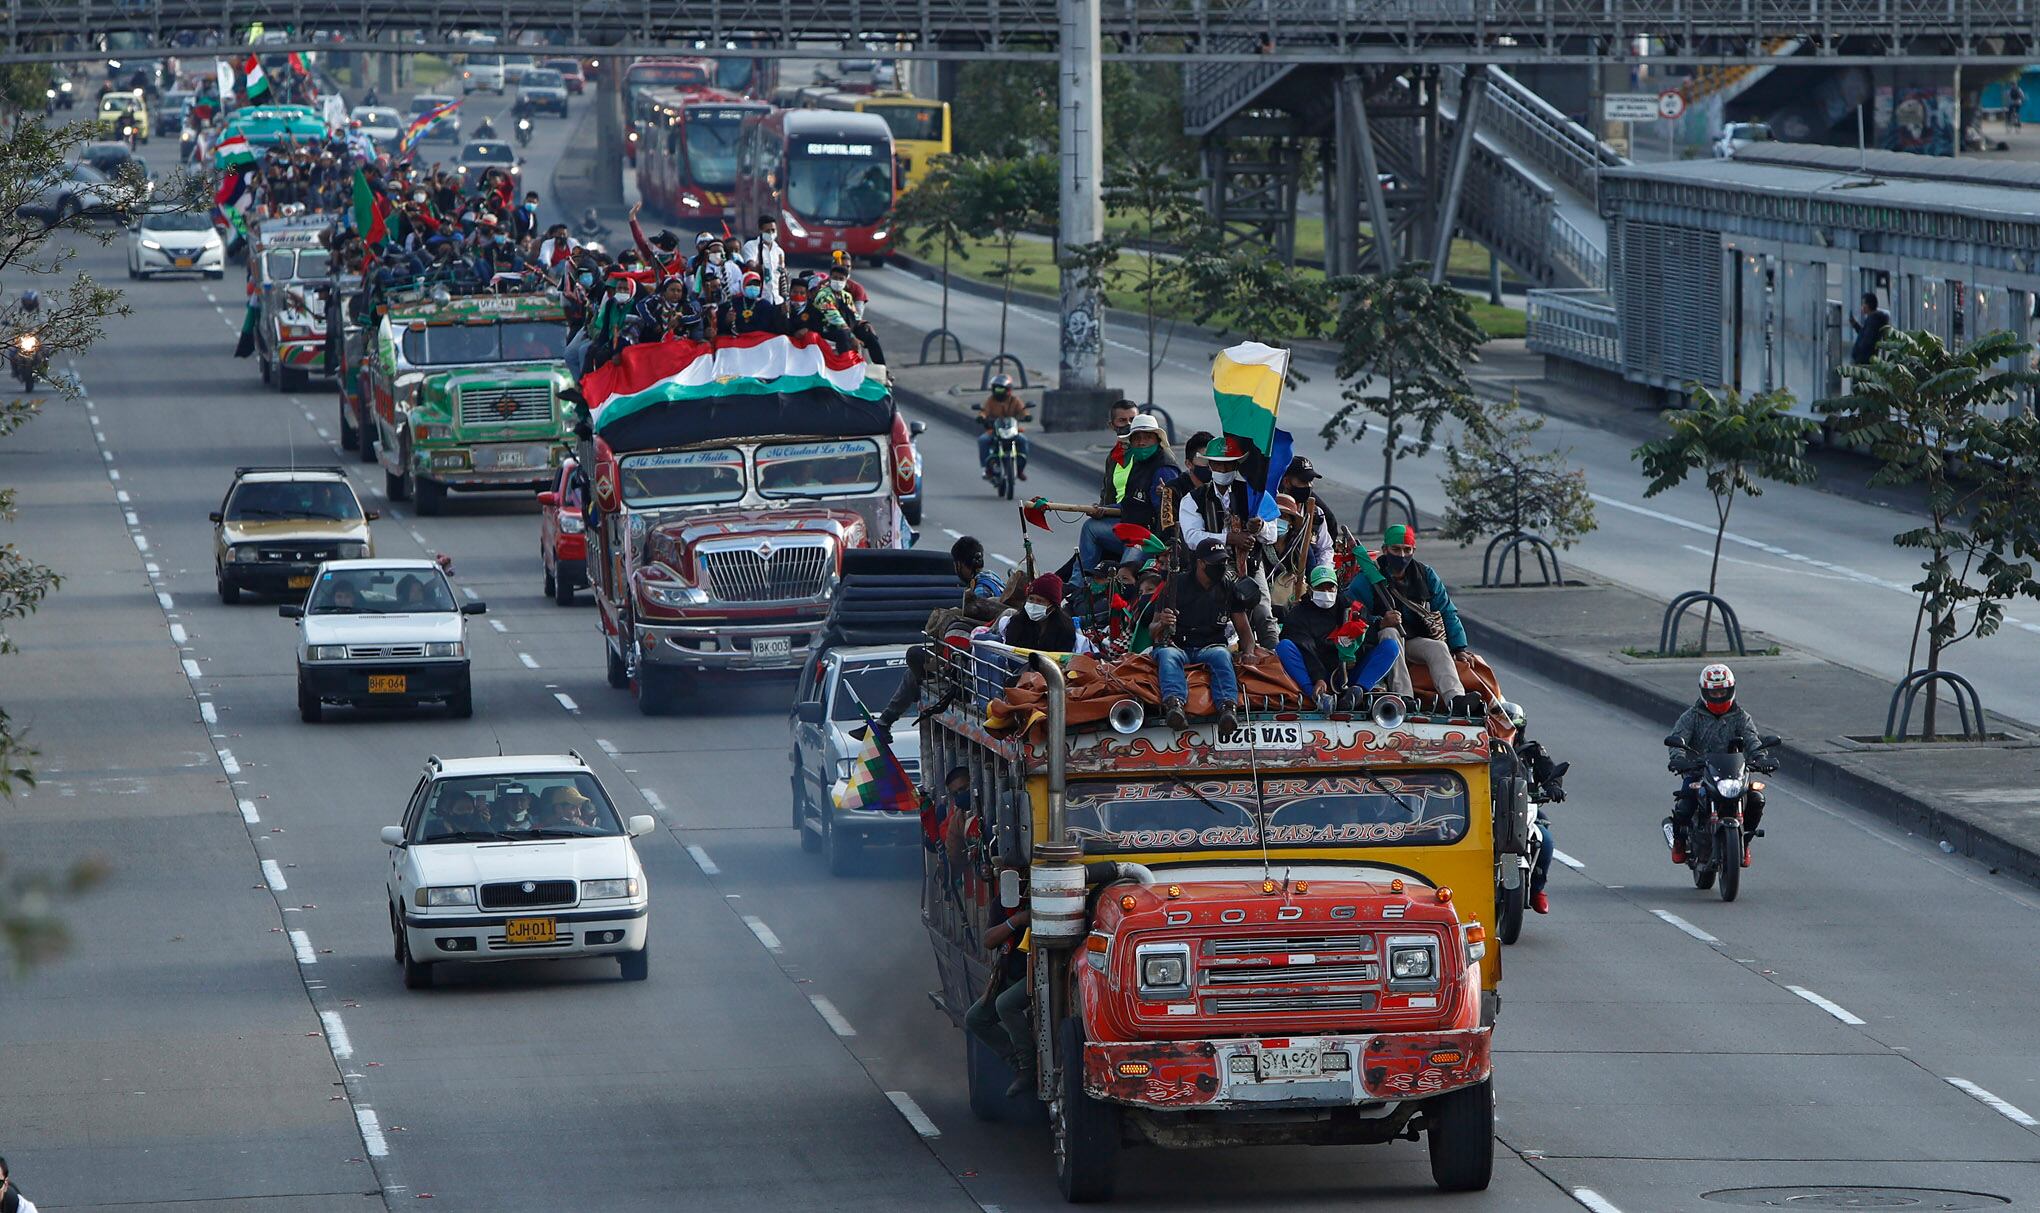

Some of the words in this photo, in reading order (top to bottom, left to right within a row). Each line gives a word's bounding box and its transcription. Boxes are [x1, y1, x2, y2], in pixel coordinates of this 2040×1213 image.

[822, 143, 848, 155] PORTAL
[849, 144, 873, 156] NORTE
[766, 447, 781, 458] Mi
[784, 446, 819, 456] Ciudad
[820, 444, 835, 454] La
[837, 442, 865, 453] Plata
[629, 458, 646, 468] Mi
[684, 454, 695, 464] el
[1261, 727, 1297, 744] SYA
[1114, 783, 1164, 800] EL
[1170, 777, 1404, 800] SOBERANO
[1118, 828, 1198, 849] TODO
[1199, 823, 1314, 847] GRACIAS
[1313, 823, 1337, 843] A
[1337, 822, 1407, 843] DIOS
[1166, 904, 1406, 925] DODGE
